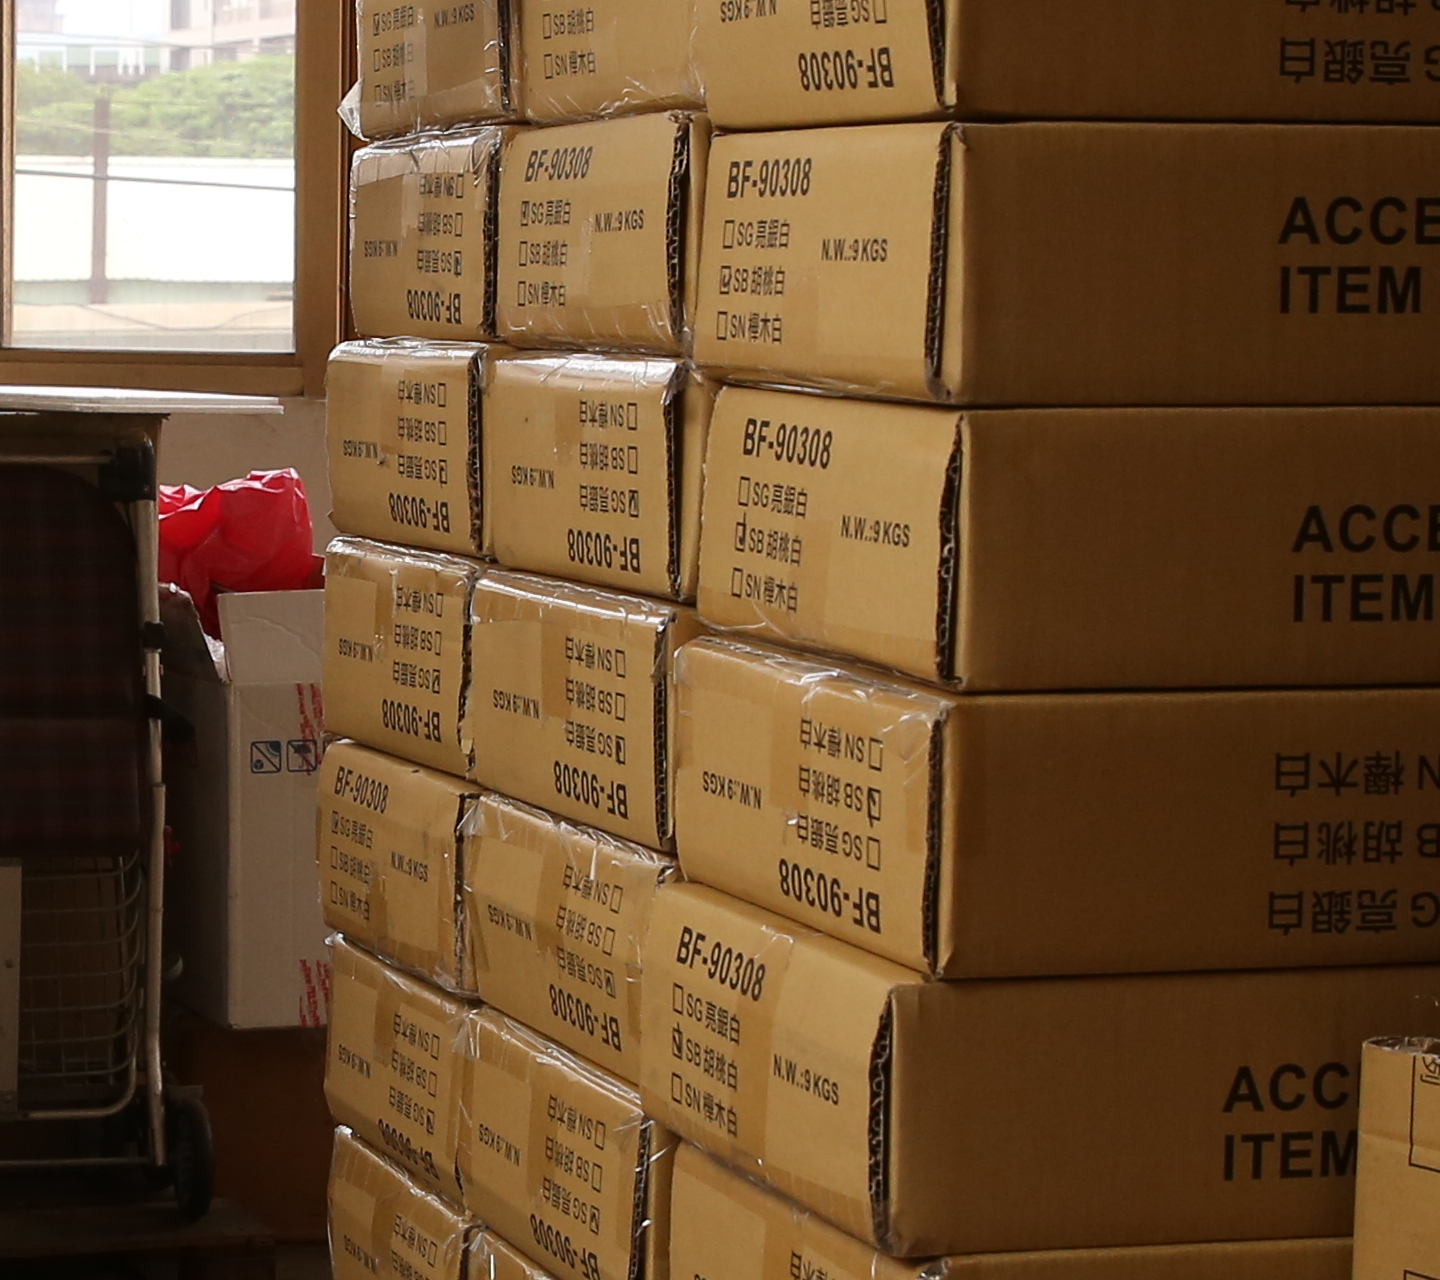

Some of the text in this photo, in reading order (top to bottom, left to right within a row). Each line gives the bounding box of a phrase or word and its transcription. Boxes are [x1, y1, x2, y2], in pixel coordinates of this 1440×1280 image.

[1280, 37, 1411, 85] 亮銀白
[1280, 266, 1421, 314] ITEM
[1294, 574, 1434, 622] ITEM
